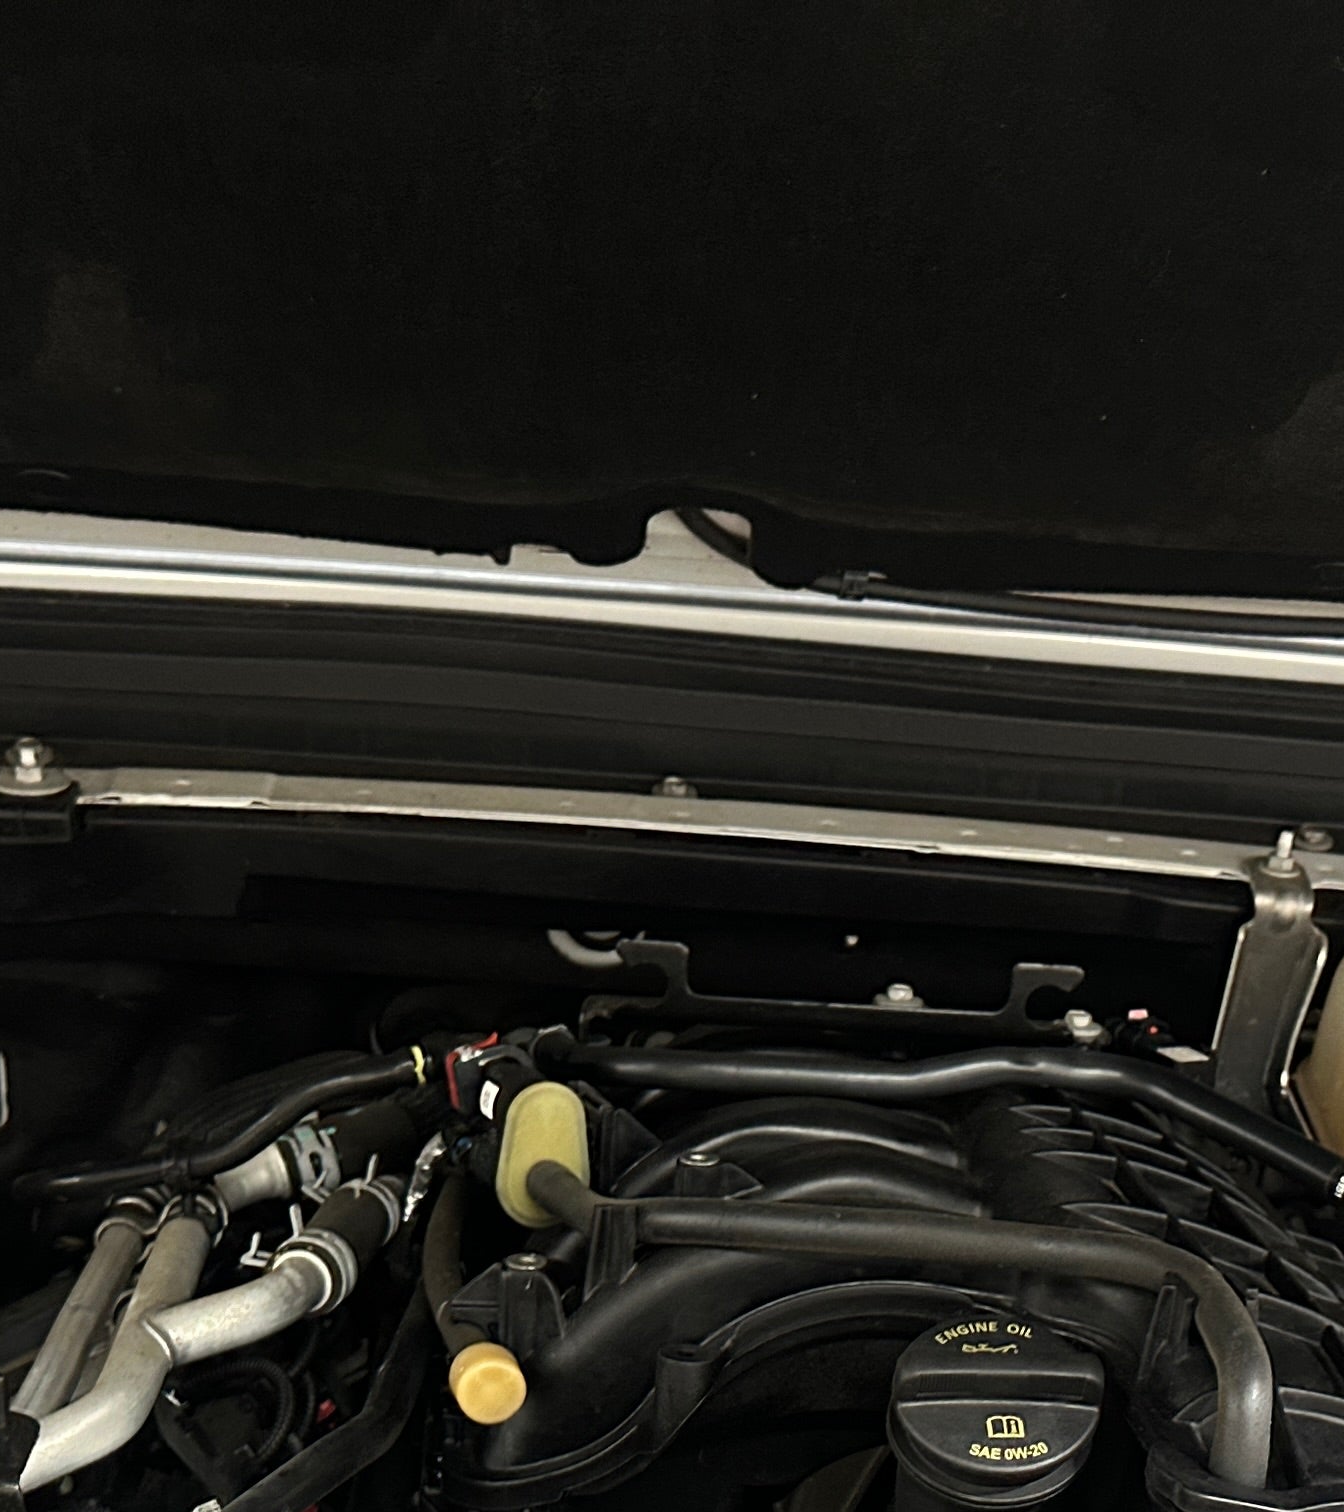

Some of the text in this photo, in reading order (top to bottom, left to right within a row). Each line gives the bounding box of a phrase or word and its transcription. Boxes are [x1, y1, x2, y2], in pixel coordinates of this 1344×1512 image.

[934, 1321, 1033, 1345] ENGINE OIL
[969, 1441, 1048, 1460] SAE 0W-20
